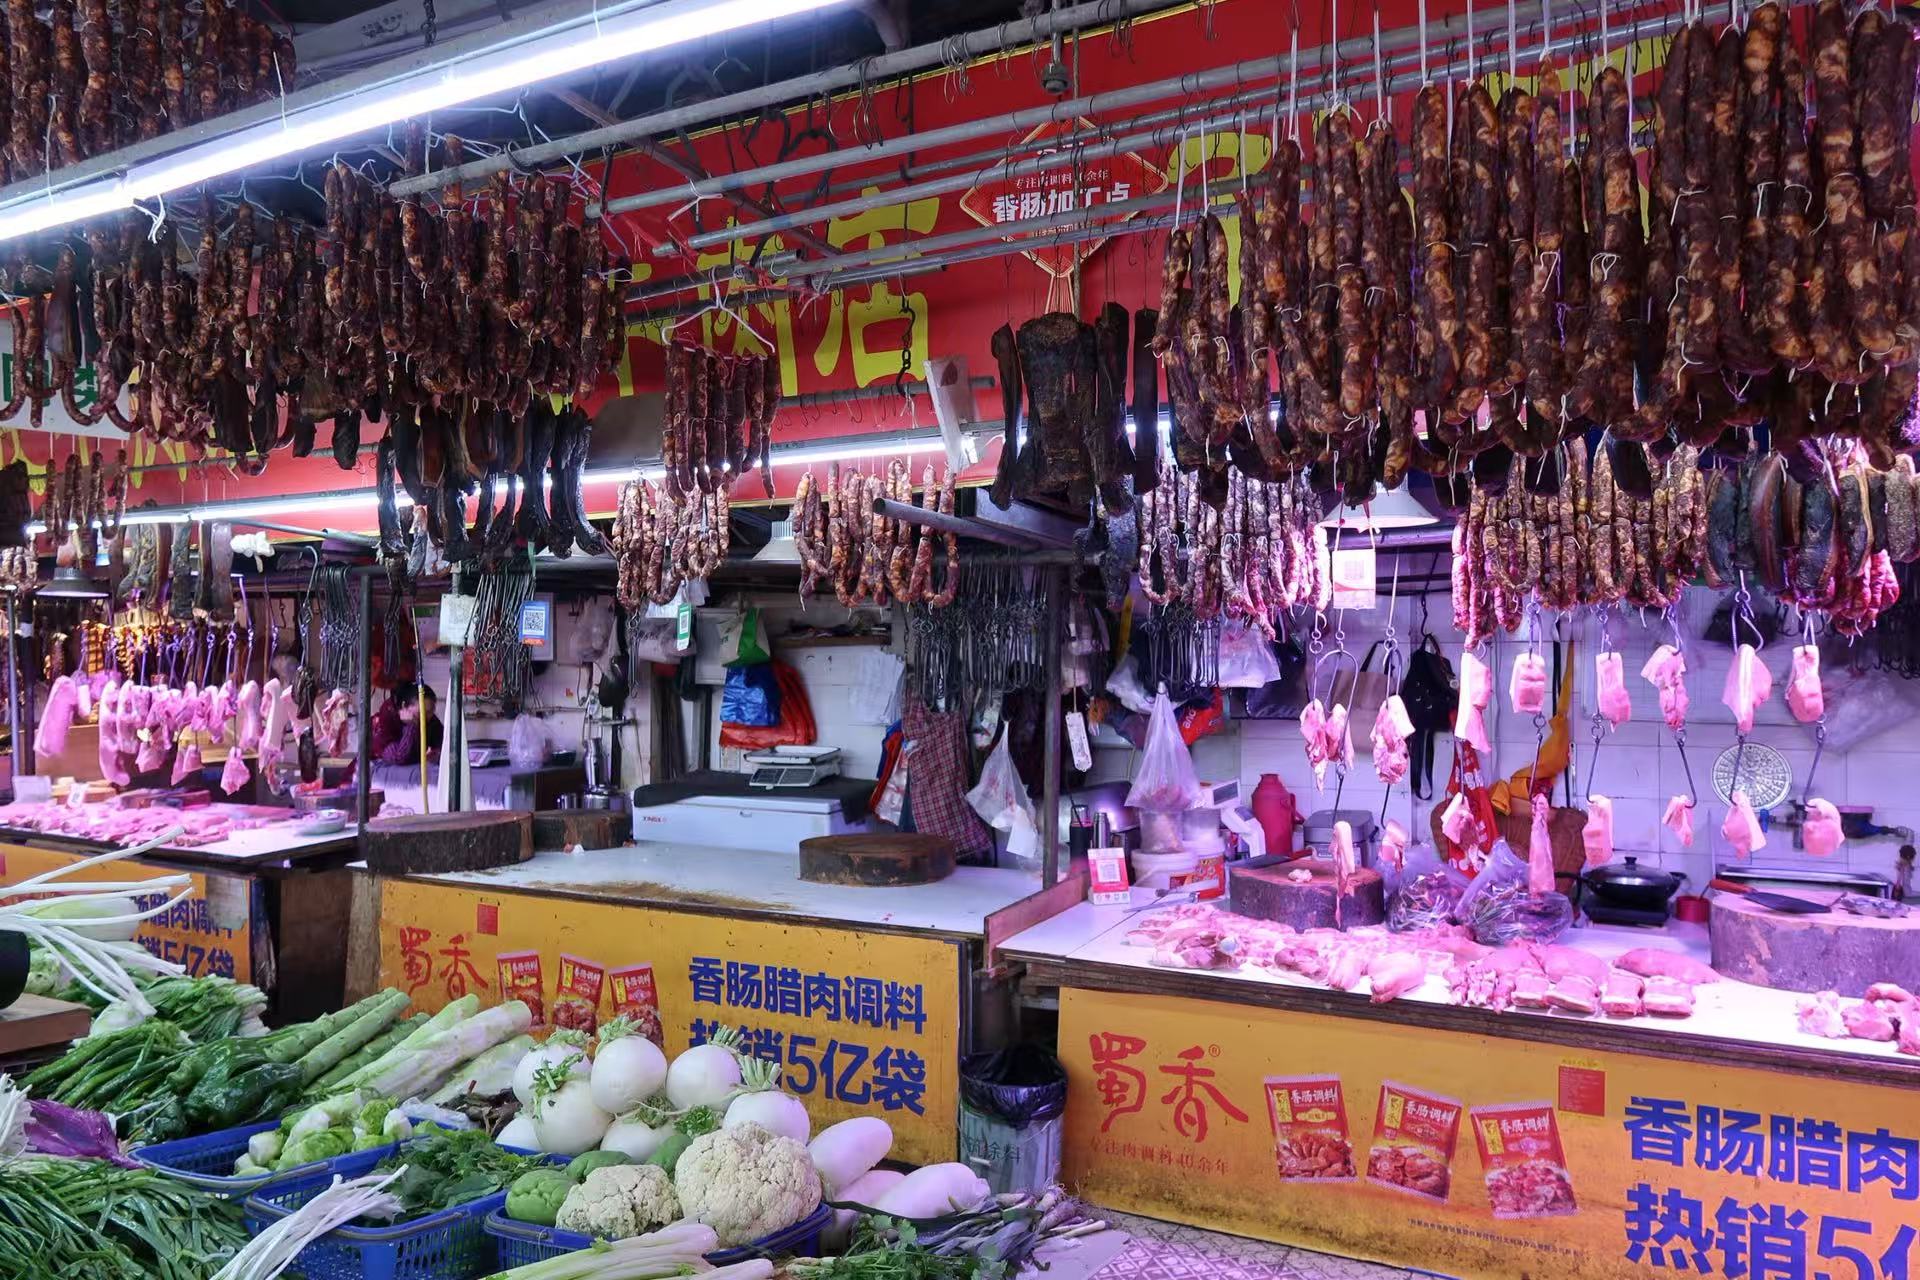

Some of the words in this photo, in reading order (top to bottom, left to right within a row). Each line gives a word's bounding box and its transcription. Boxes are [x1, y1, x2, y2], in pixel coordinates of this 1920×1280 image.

[689, 957, 927, 1034] 香肠腊肉调料
[1089, 1031, 1249, 1143] 蜀香
[1405, 1100, 1457, 1126] 香肠调料
[1623, 1096, 1920, 1201] 香肠腊肉
